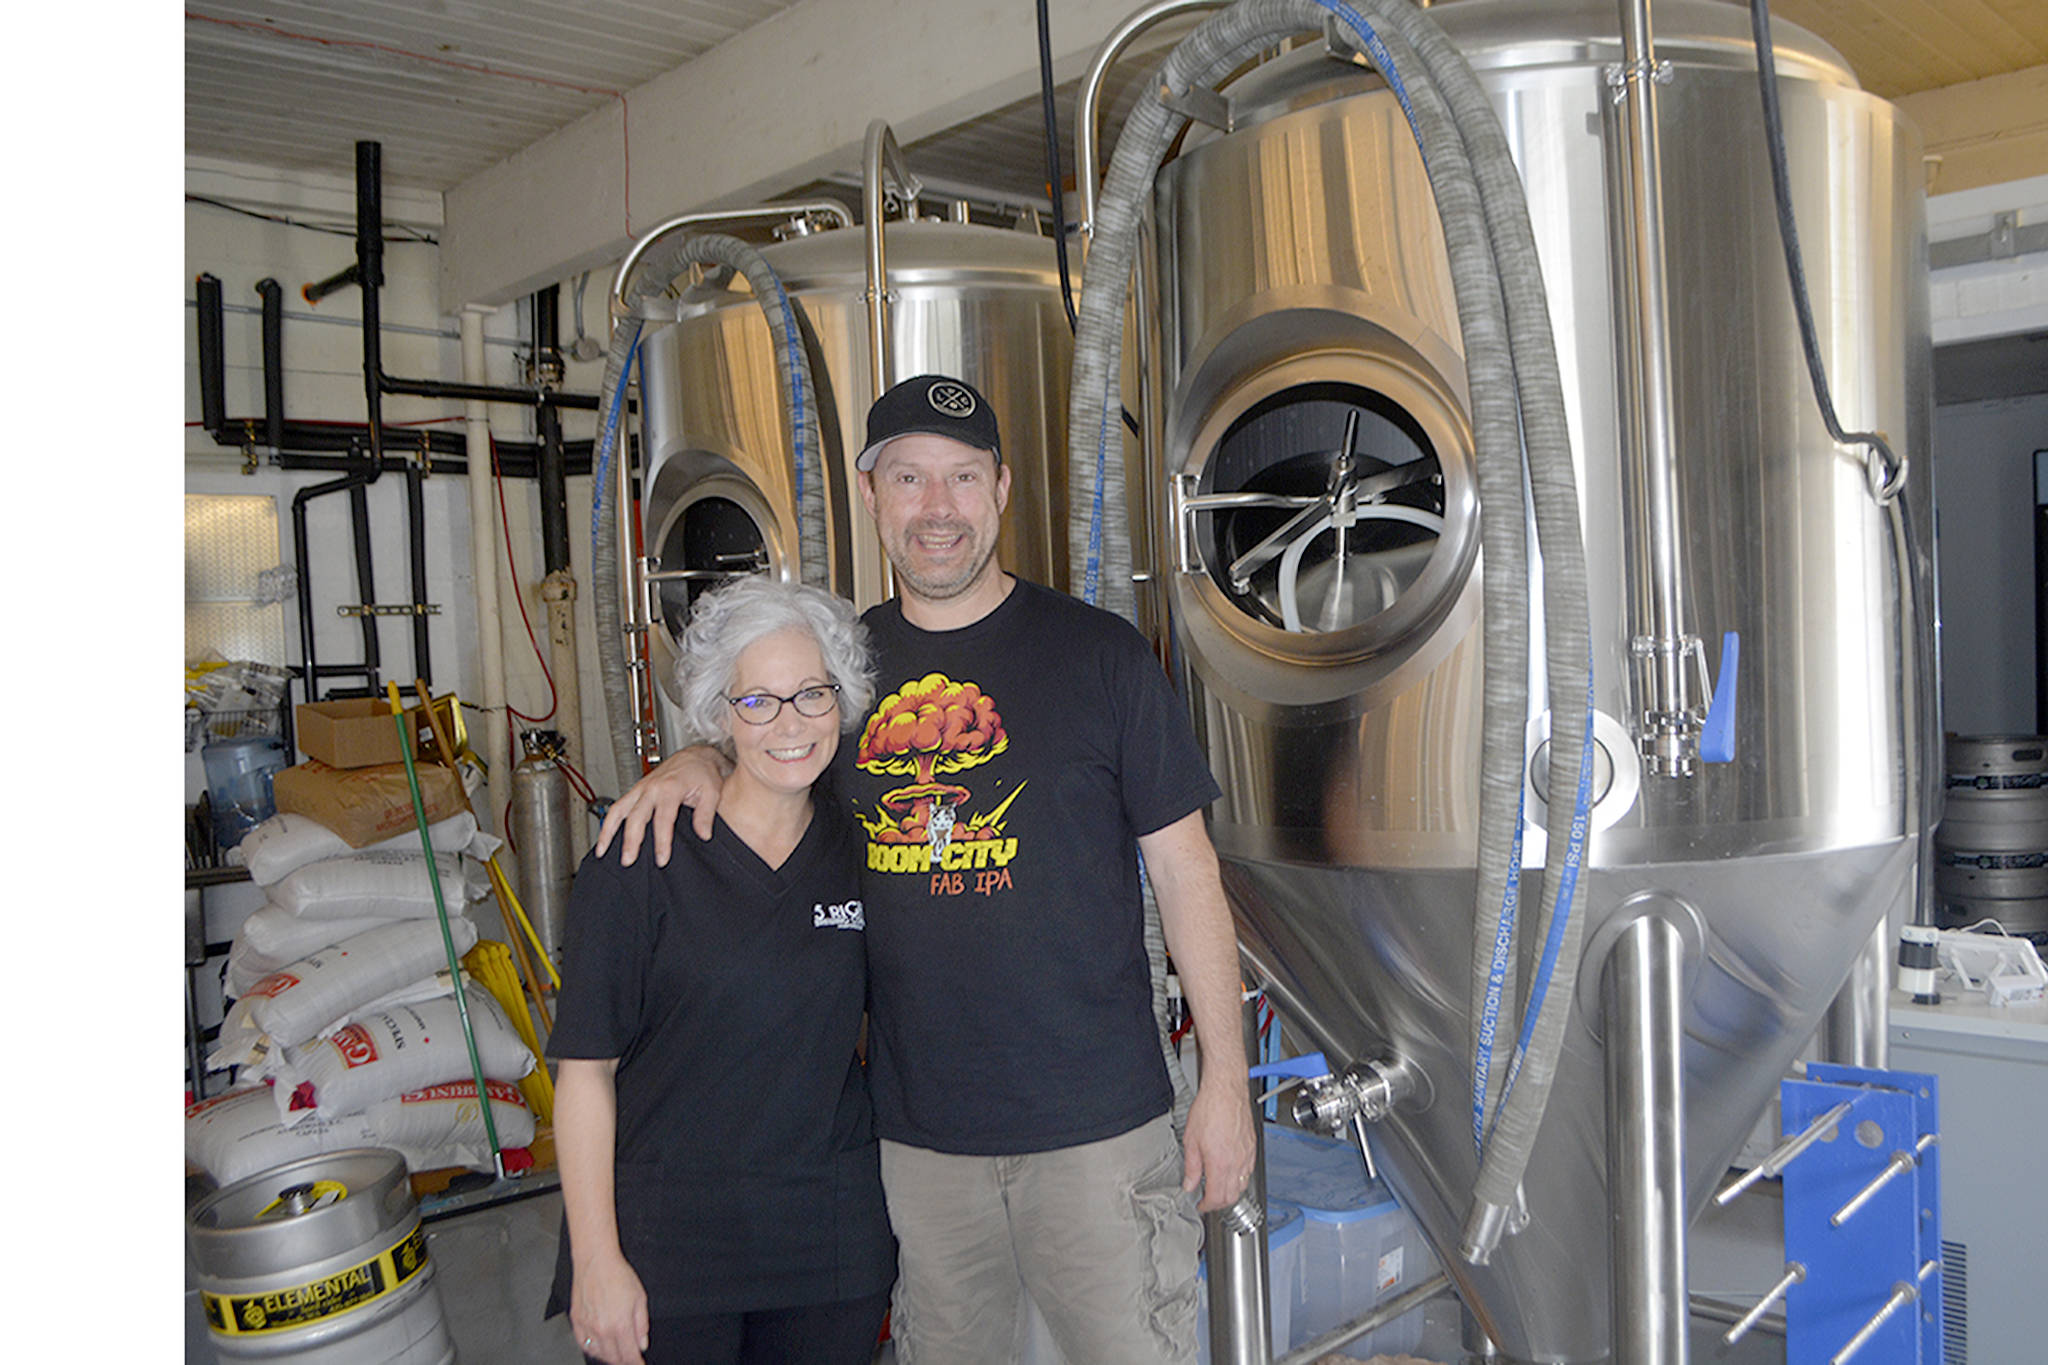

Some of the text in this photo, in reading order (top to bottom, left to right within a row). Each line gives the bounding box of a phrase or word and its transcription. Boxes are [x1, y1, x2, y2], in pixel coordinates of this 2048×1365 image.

[1571, 815, 1586, 839] 150
[940, 837, 1019, 871] CITY
[1566, 842, 1582, 868] PSI
[930, 867, 1014, 896] FAB IPA
[1493, 974, 1504, 984] &
[1480, 986, 1501, 1046] SUCTION
[1473, 1046, 1490, 1107] SANITARY
[263, 1267, 369, 1314] ELEMENTAL
